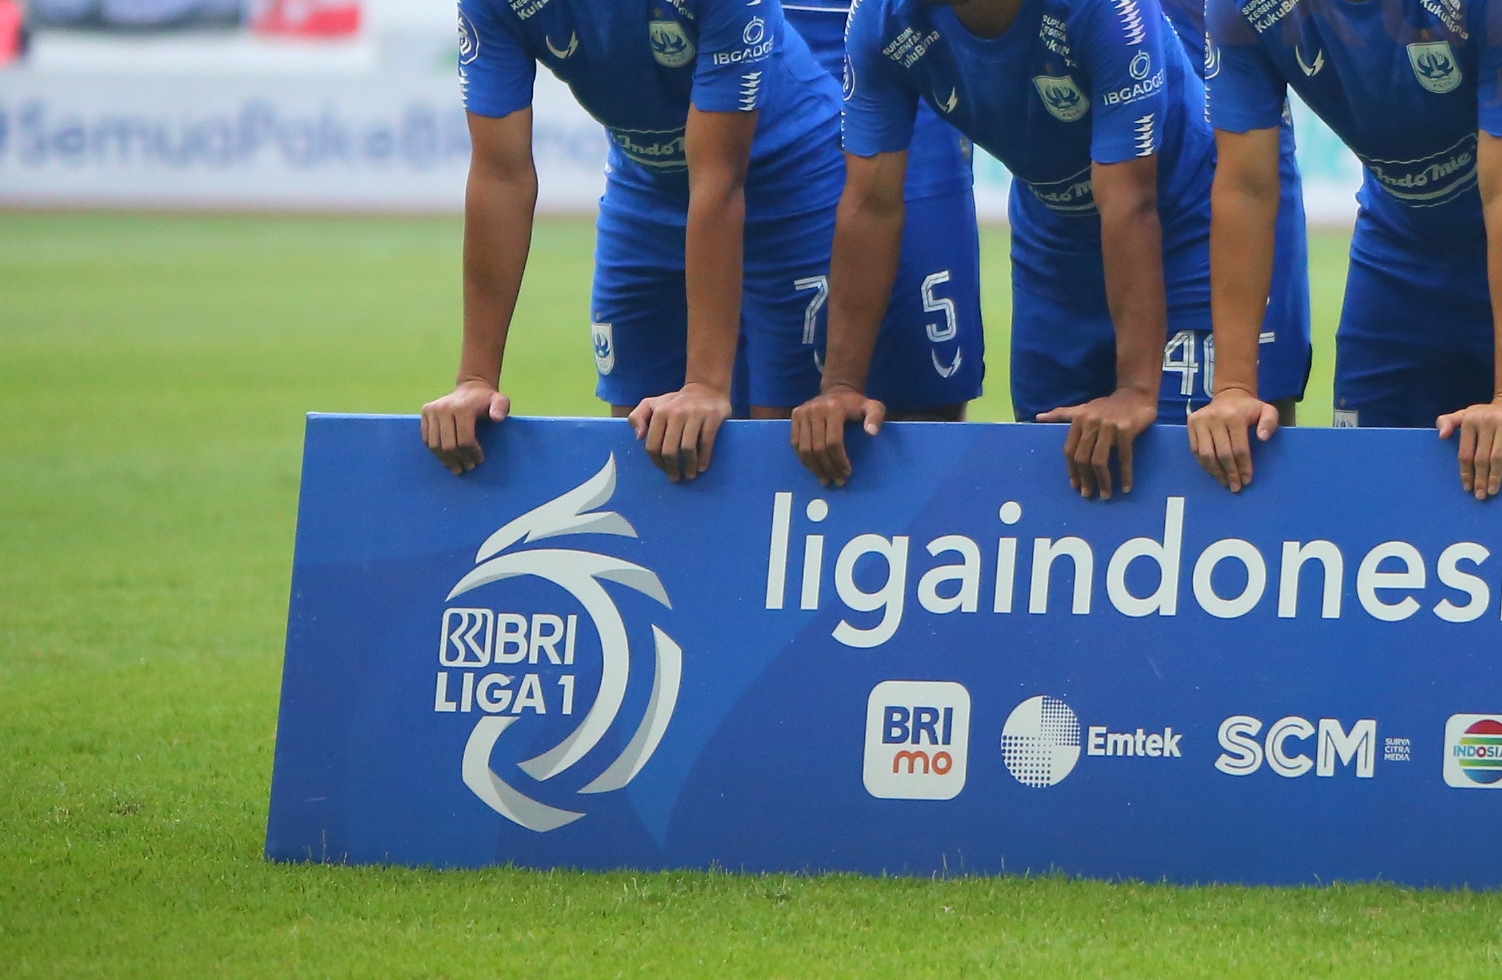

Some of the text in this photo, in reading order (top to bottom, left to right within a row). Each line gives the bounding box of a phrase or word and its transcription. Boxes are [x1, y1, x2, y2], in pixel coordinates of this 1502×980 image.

[794, 275, 828, 344] 7
[921, 270, 957, 342] 5
[494, 612, 578, 665] BRI
[434, 671, 575, 715] LIGA 1
[881, 706, 954, 745] BRI
[1087, 726, 1183, 758] Emtek
[1384, 737, 1411, 746] SURYA
[892, 750, 953, 776] mo
[1214, 714, 1378, 779] SCM
[1383, 753, 1411, 761] MEDIA
[1384, 745, 1411, 753] CITRA
